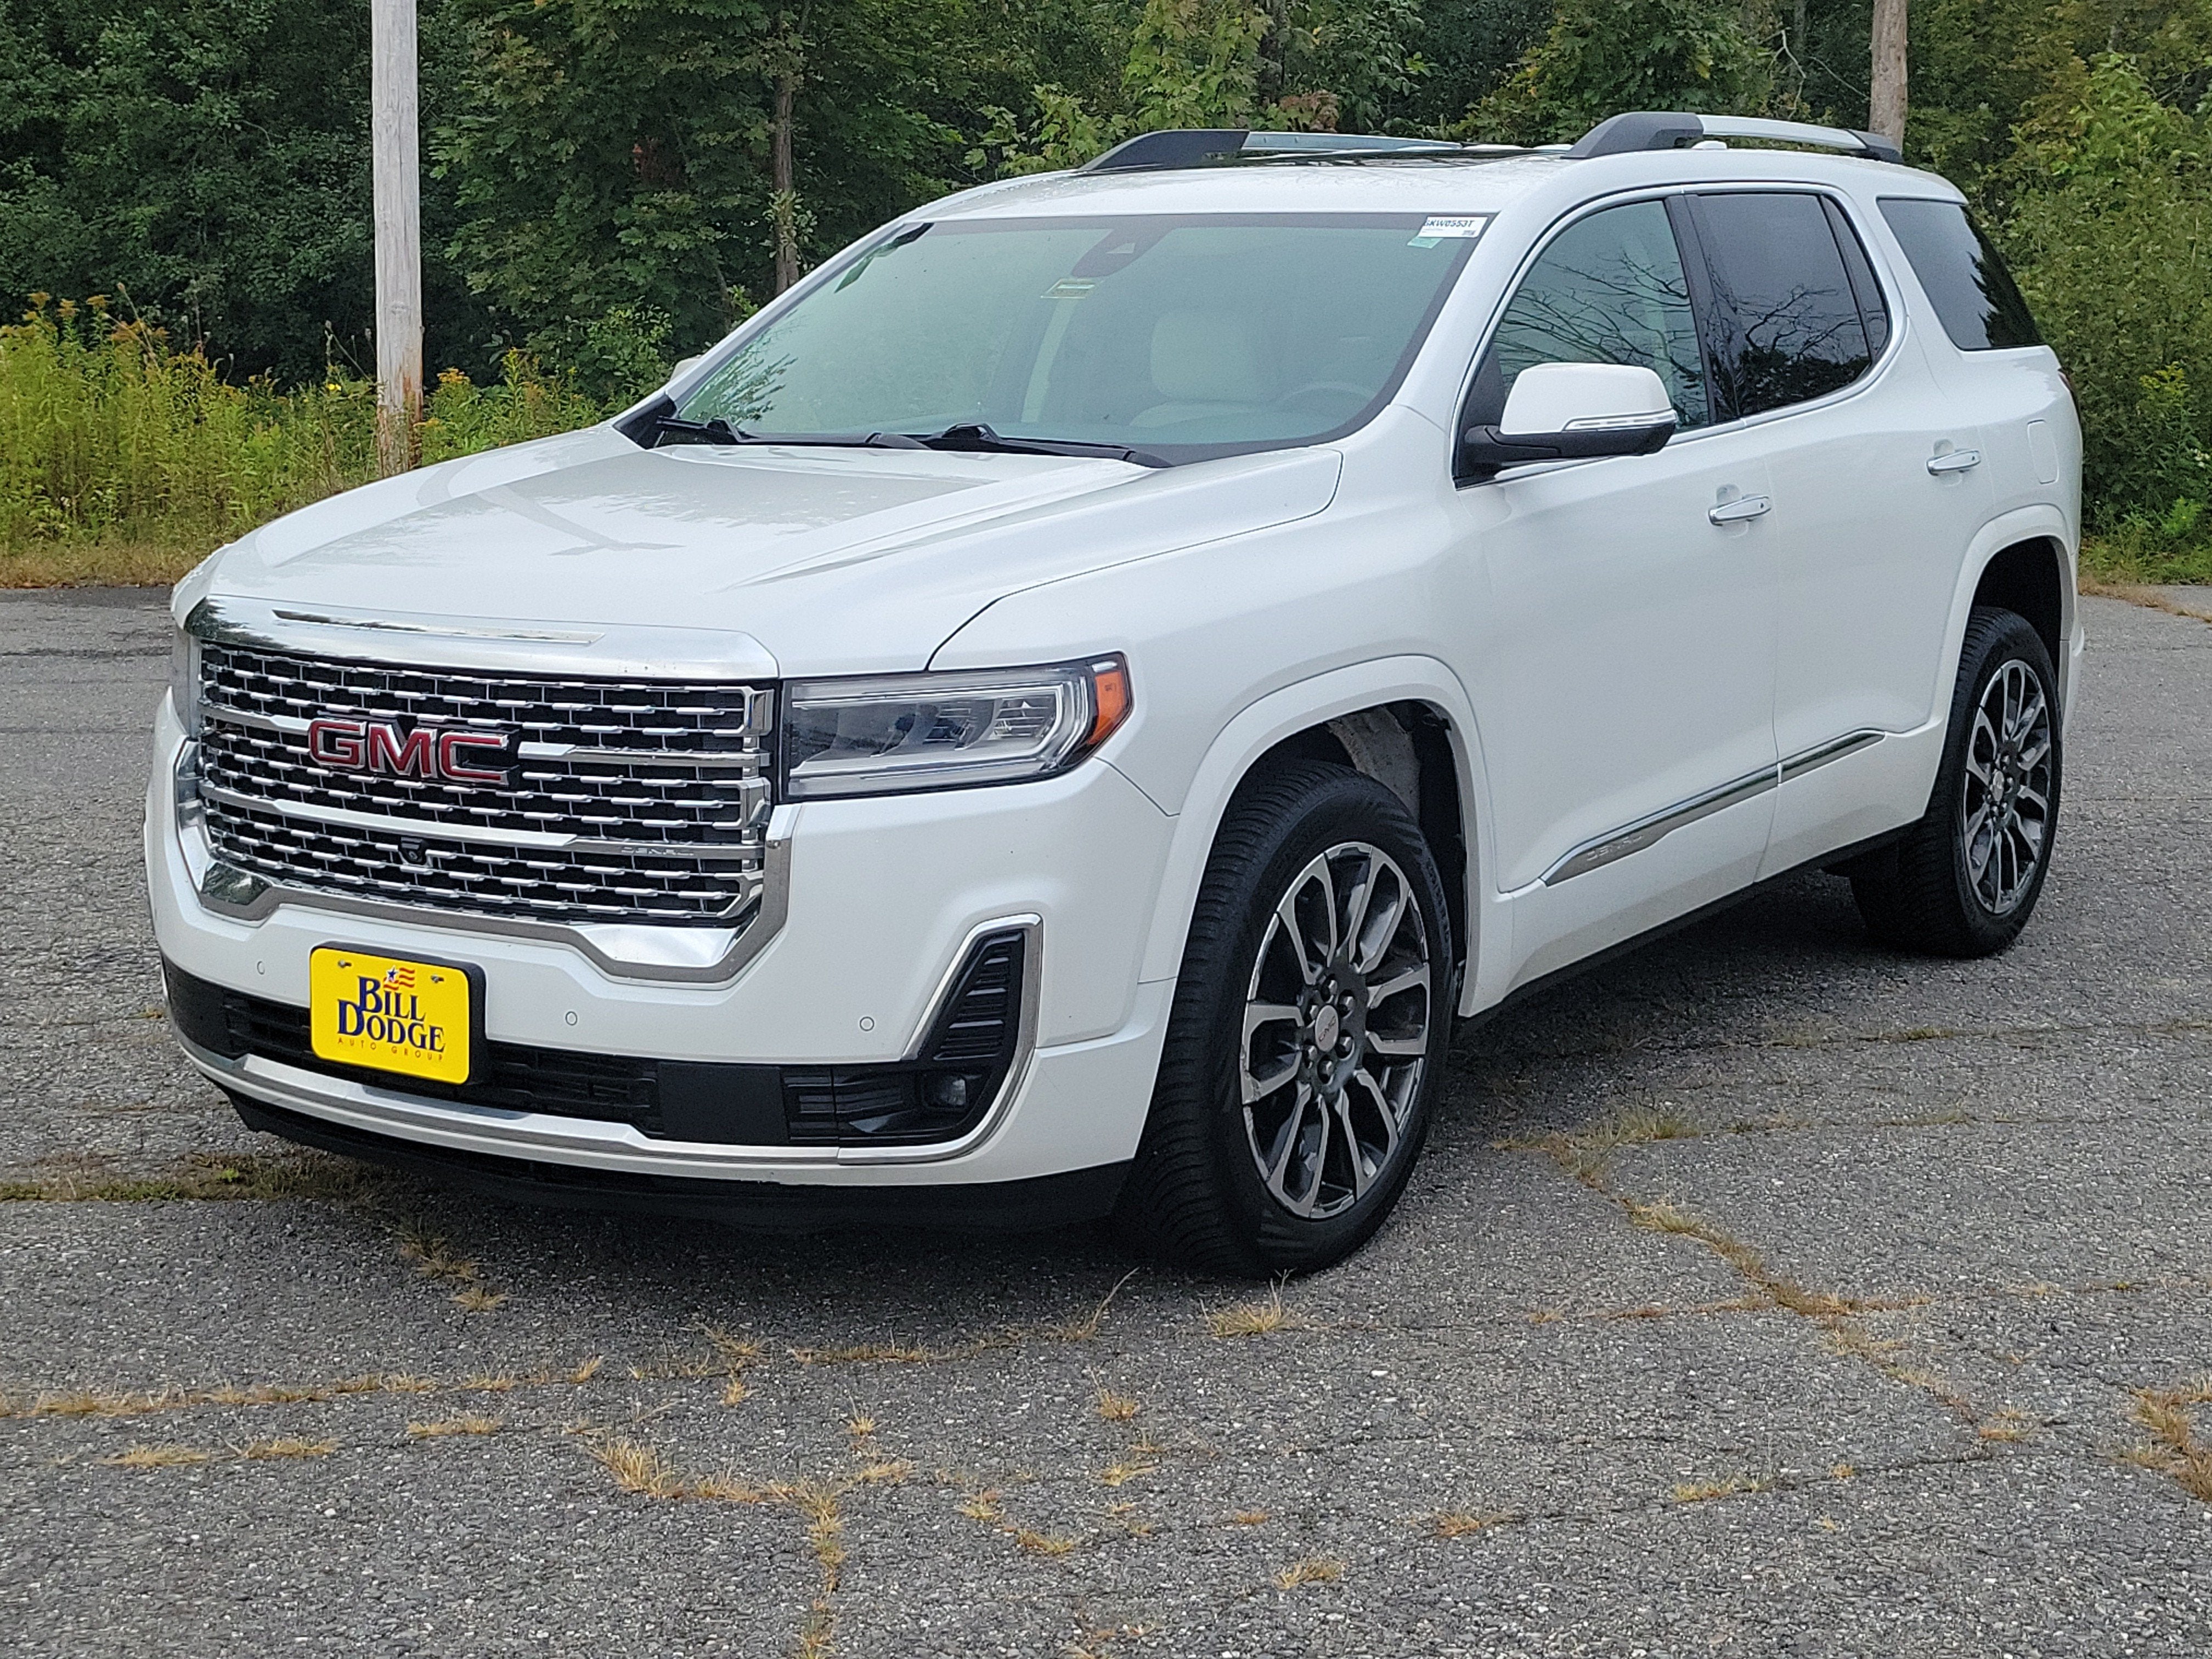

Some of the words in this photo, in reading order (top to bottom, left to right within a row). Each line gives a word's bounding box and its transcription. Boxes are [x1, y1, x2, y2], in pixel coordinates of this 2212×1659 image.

[308, 718, 510, 786] GMC
[358, 975, 426, 1022] BILL
[337, 998, 445, 1053] DODGE
[337, 1037, 377, 1050] AUTO
[391, 1046, 443, 1060] GROUP
